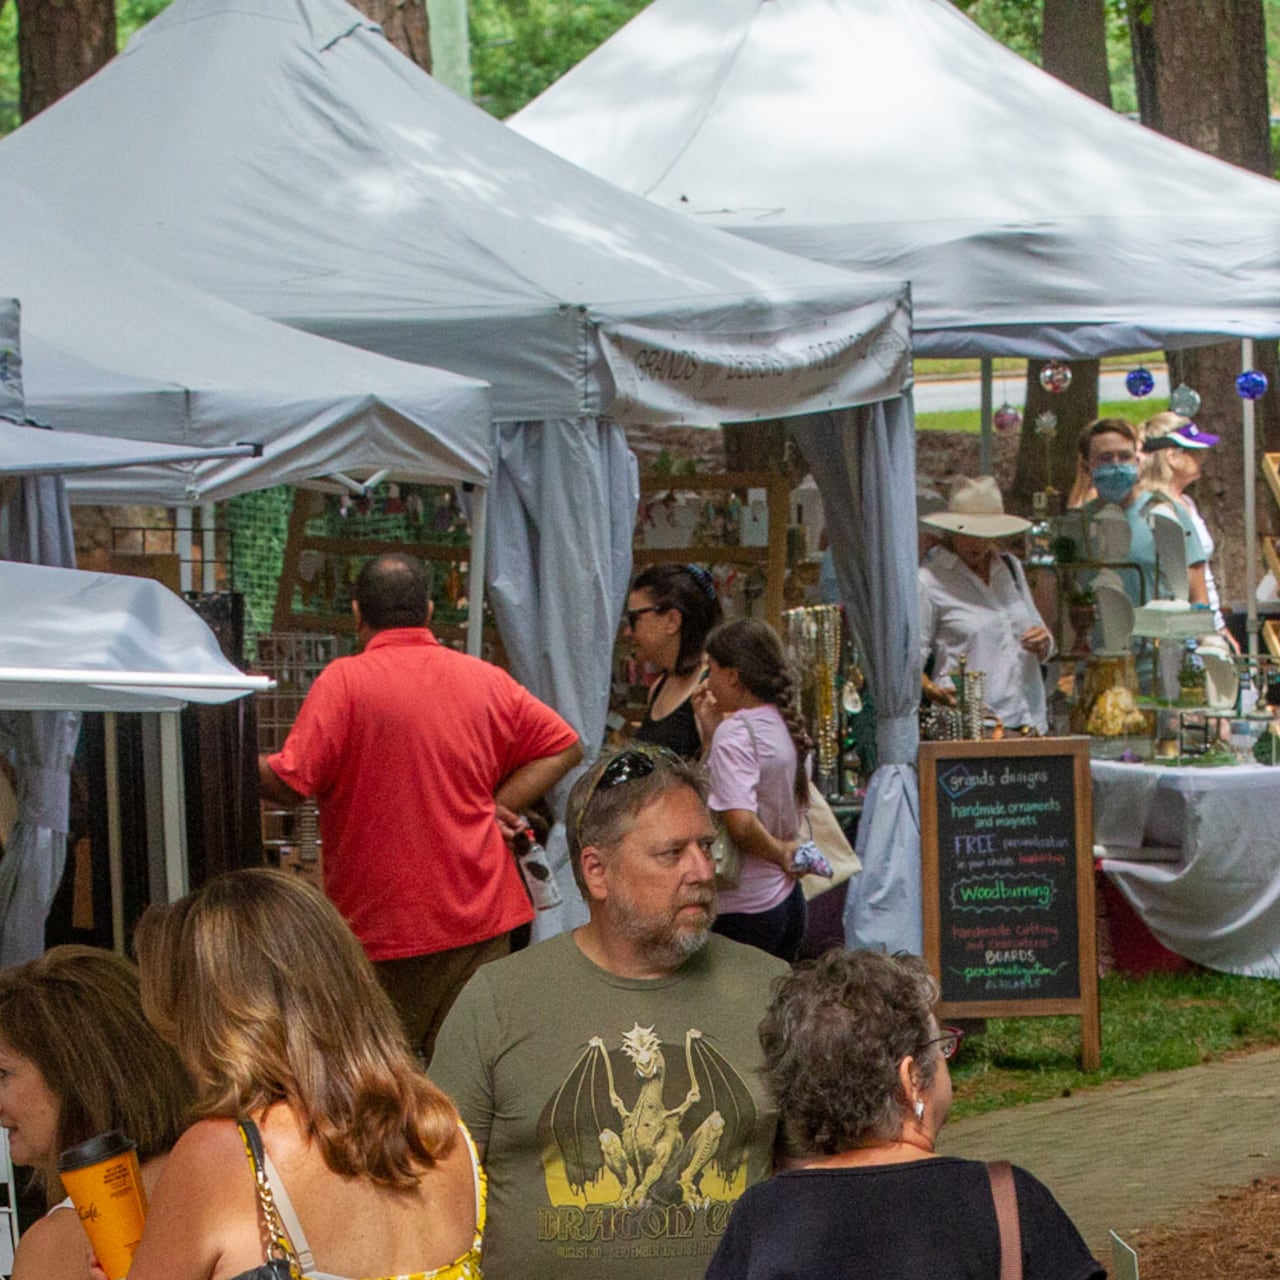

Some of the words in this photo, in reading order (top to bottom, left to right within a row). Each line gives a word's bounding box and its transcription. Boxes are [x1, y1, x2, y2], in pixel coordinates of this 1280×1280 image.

[1000, 767, 1048, 789] designs
[975, 817, 993, 828] and
[995, 814, 1038, 829] magnets
[954, 833, 997, 854] FREE
[985, 949, 1036, 964] BOARDS
[538, 1203, 695, 1242] DRAGON
